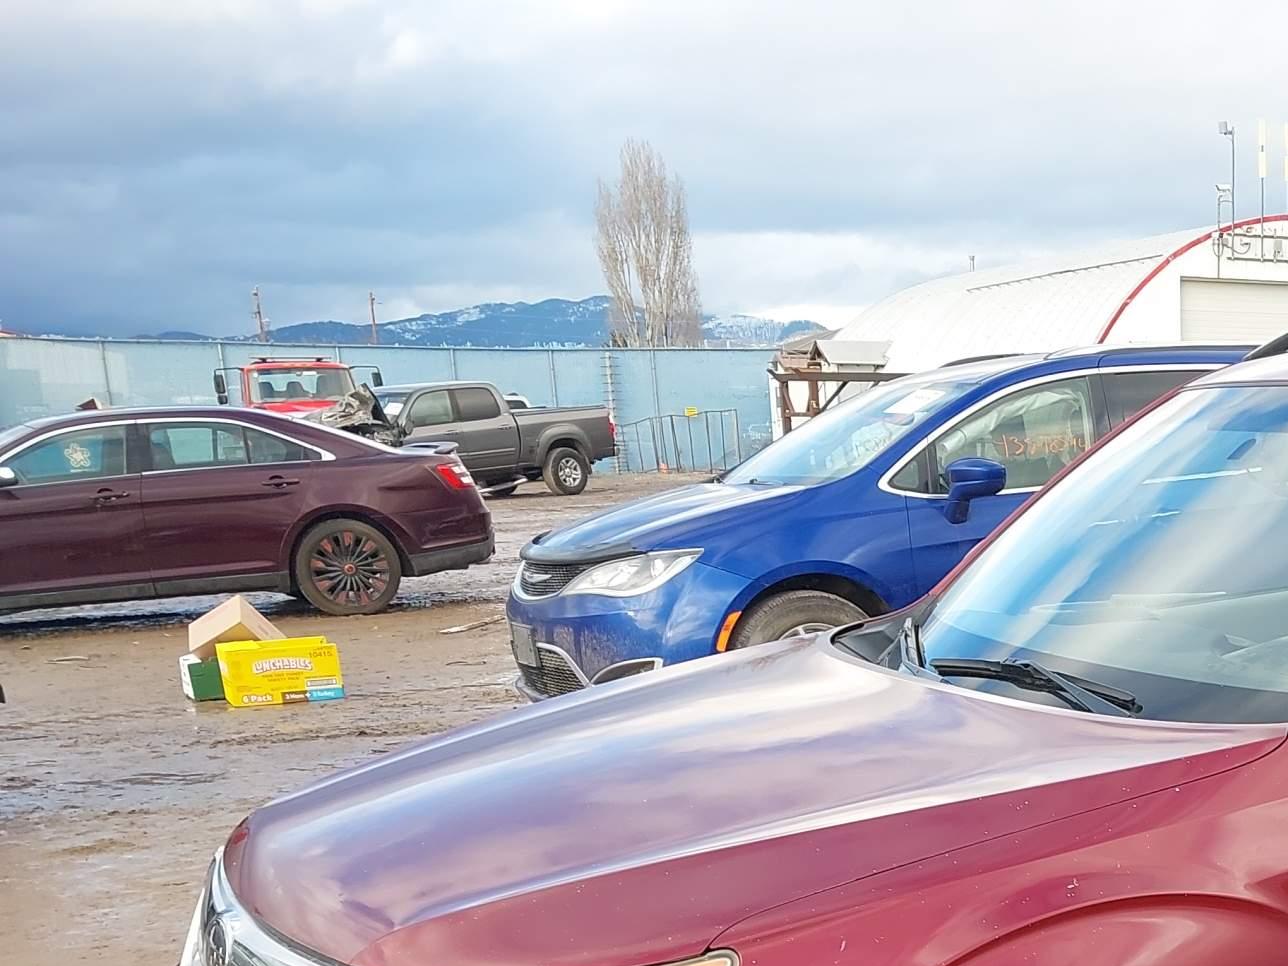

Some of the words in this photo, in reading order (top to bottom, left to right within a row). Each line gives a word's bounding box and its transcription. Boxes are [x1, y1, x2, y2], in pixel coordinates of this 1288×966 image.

[253, 657, 313, 674] LUNCHABLES
[243, 694, 249, 703] 6
[251, 693, 273, 703] Pack
